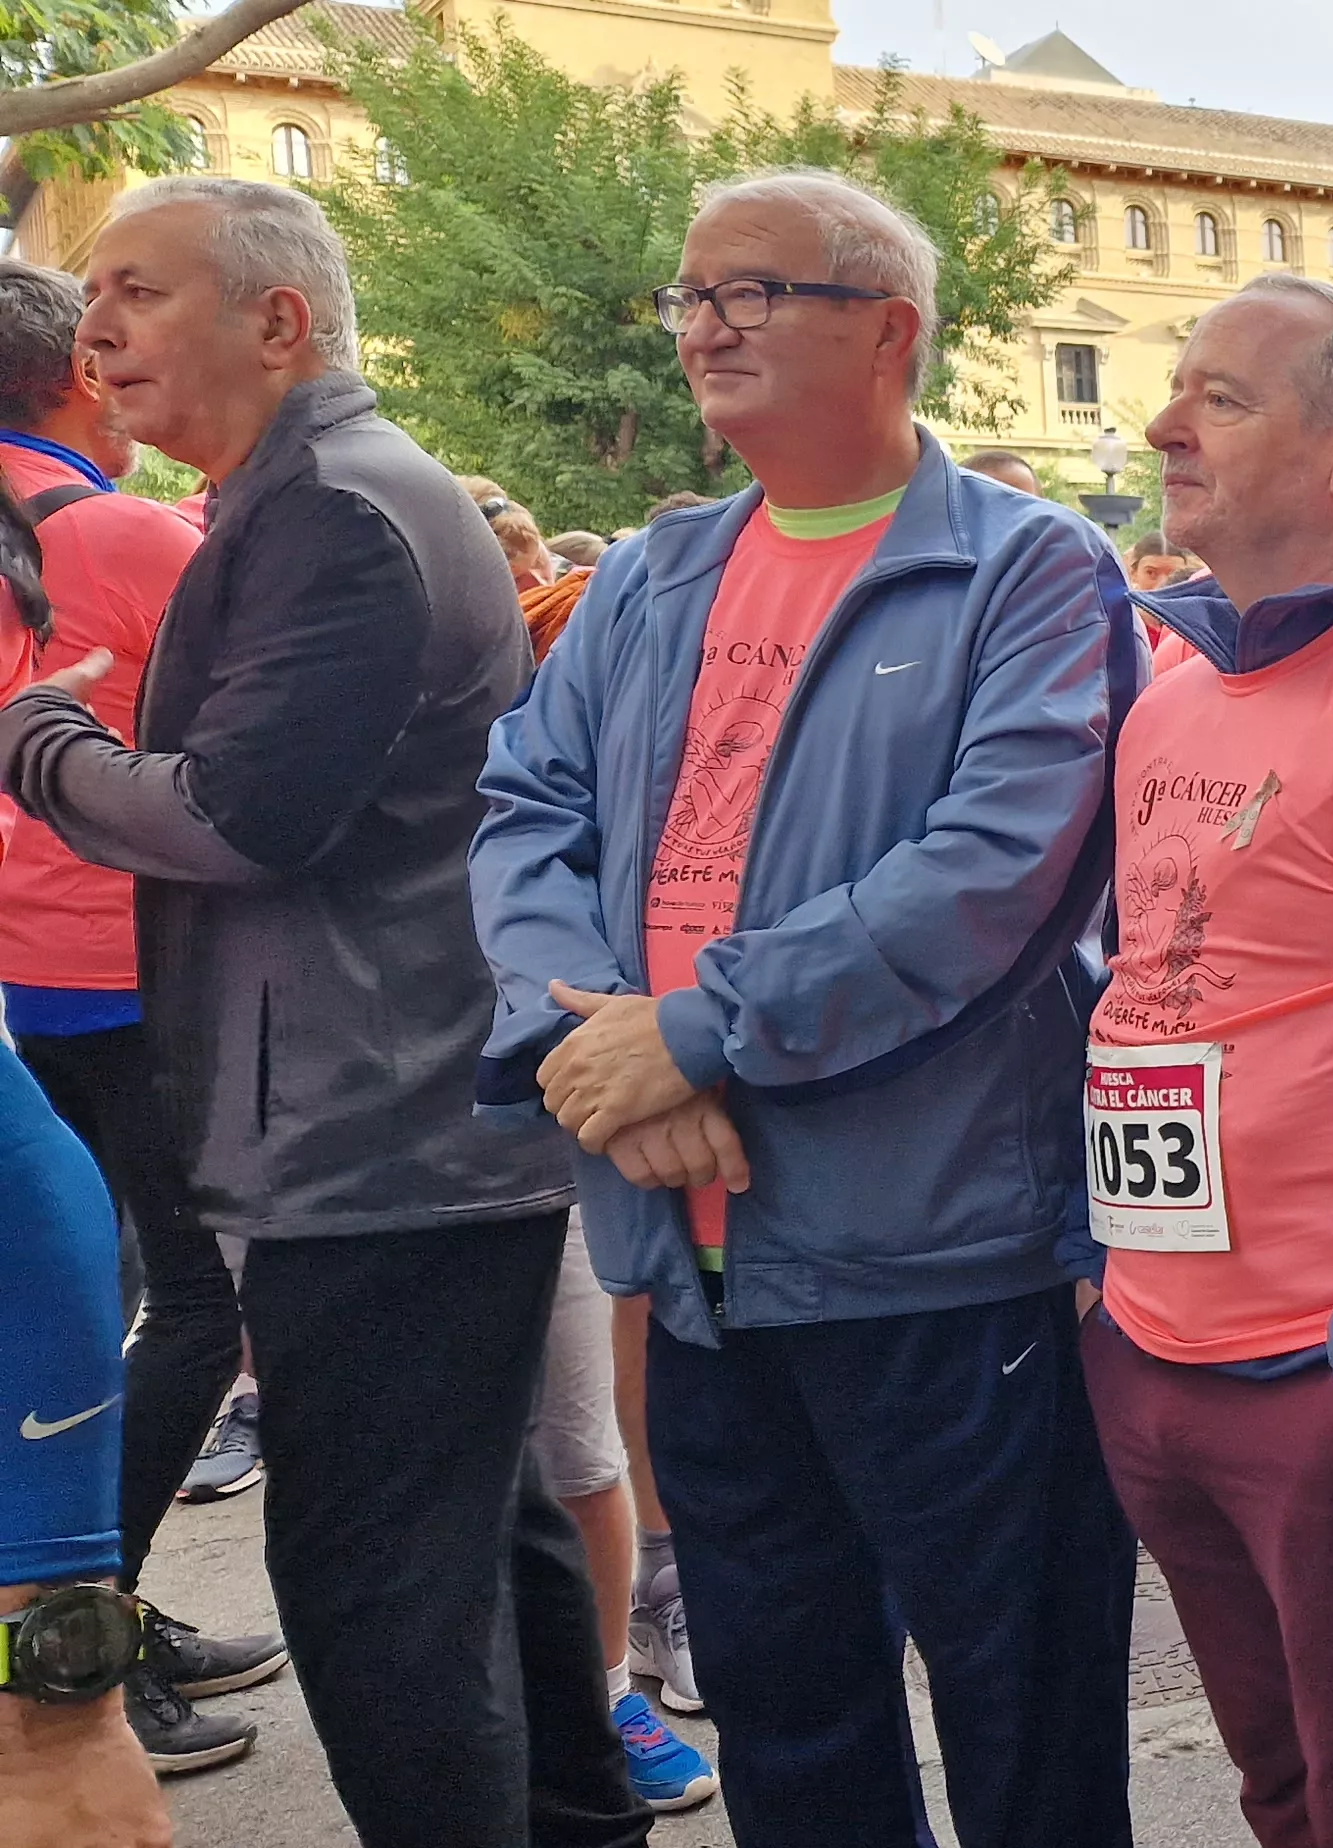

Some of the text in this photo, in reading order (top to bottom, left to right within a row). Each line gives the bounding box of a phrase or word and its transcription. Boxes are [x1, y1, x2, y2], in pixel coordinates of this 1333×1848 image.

[727, 637, 807, 669] CÁNC
[1138, 778, 1167, 826] 9ª
[1170, 771, 1248, 807] CÁNCER
[1197, 806, 1238, 826] HUES
[650, 861, 713, 885] IÉRETE
[1099, 1072, 1134, 1086] HUESCA
[1126, 1085, 1194, 1108] CÁNCER
[1090, 1119, 1201, 1199] 1053
